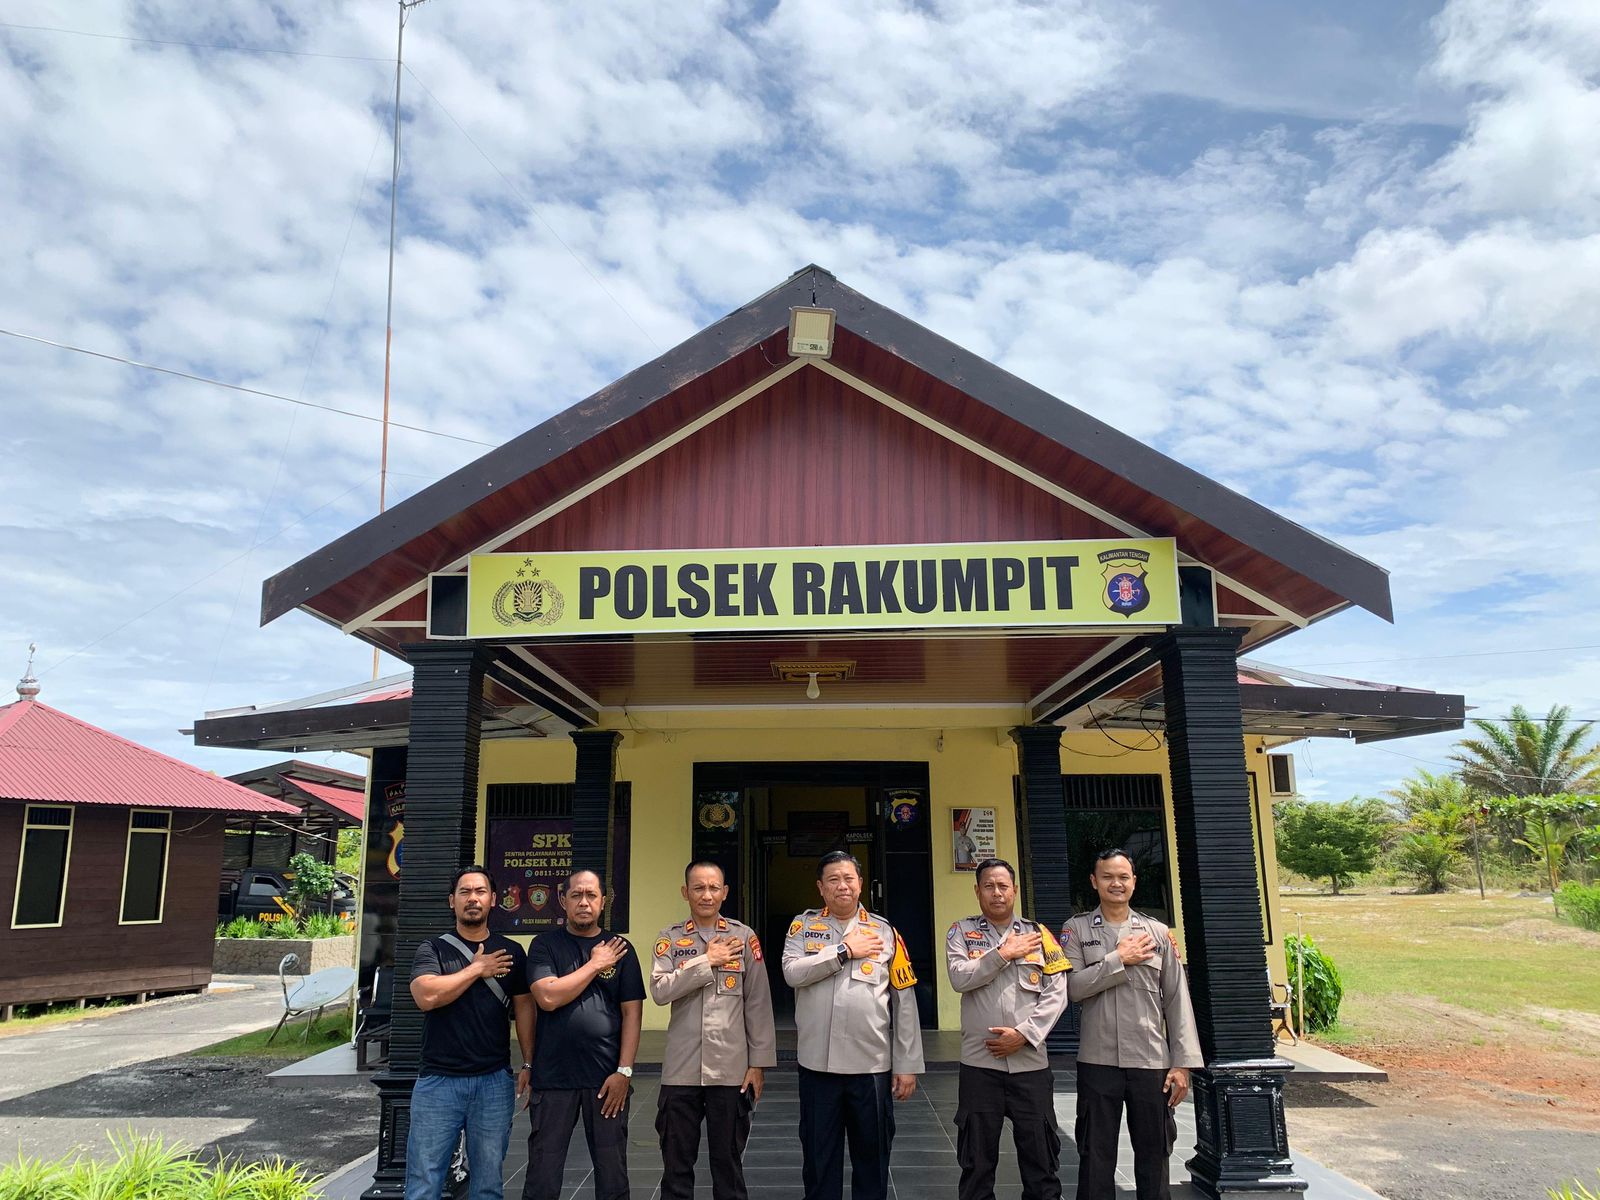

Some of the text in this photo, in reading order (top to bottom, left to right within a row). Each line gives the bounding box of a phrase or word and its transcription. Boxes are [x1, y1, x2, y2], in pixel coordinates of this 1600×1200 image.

[1099, 551, 1148, 561] KALIMANTAN TENGAH
[578, 556, 1080, 620] POLSEK RAKUMPIT
[532, 833, 574, 848] SPK
[503, 858, 548, 868] POLSEK
[534, 869, 572, 877] 0811-523
[804, 931, 831, 940] DEDY.S
[673, 949, 698, 958] JOKO
[896, 968, 909, 985] KA
